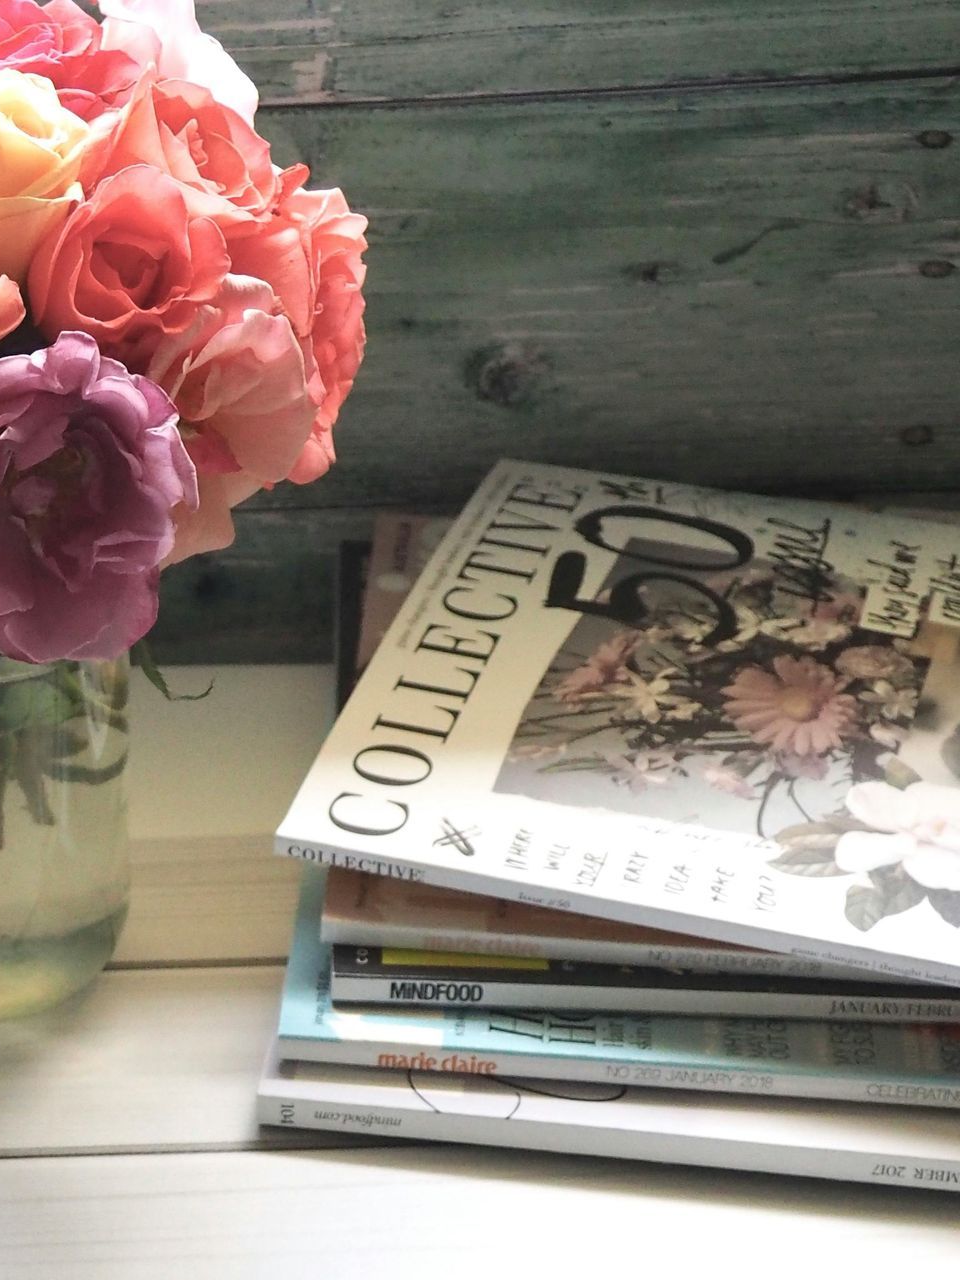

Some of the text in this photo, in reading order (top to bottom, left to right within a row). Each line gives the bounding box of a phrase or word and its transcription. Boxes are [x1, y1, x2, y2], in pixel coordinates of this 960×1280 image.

[328, 484, 581, 836] COLLECTIVE
[287, 844, 421, 882] COLLECTIVE
[664, 863, 692, 895] IDEA
[377, 1052, 497, 1075] marie claire
[607, 1066, 630, 1078] NO
[665, 1070, 733, 1084] JANUARY
[740, 1075, 774, 1089] 2018
[314, 1110, 402, 1128] mindfood.com
[872, 1163, 906, 1177] 2017
